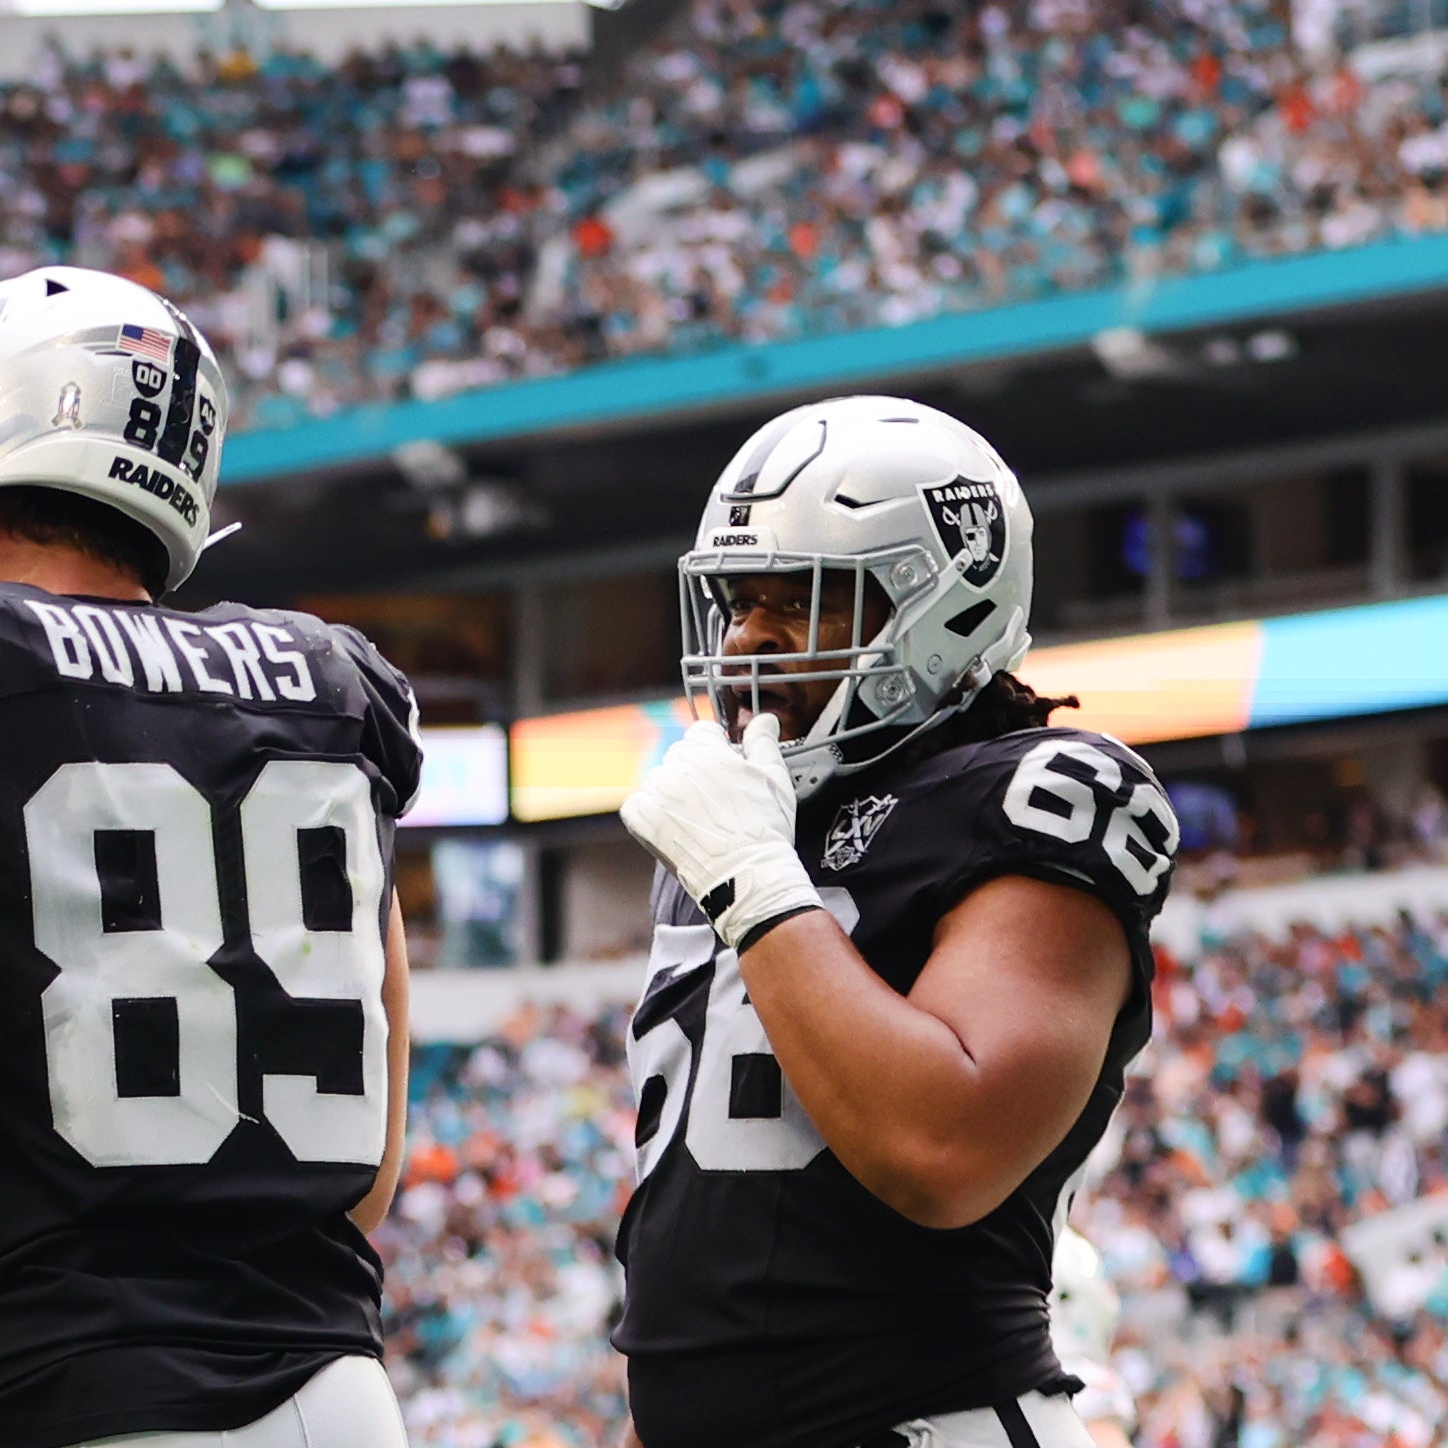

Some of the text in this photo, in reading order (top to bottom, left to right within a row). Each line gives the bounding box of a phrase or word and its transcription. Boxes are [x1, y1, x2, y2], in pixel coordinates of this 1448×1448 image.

[108, 456, 201, 529] RAIDERS
[932, 484, 995, 503] RAIDERS
[712, 534, 759, 548] RAIDERS
[23, 600, 318, 703] BOWERS
[23, 760, 390, 1167] 89
